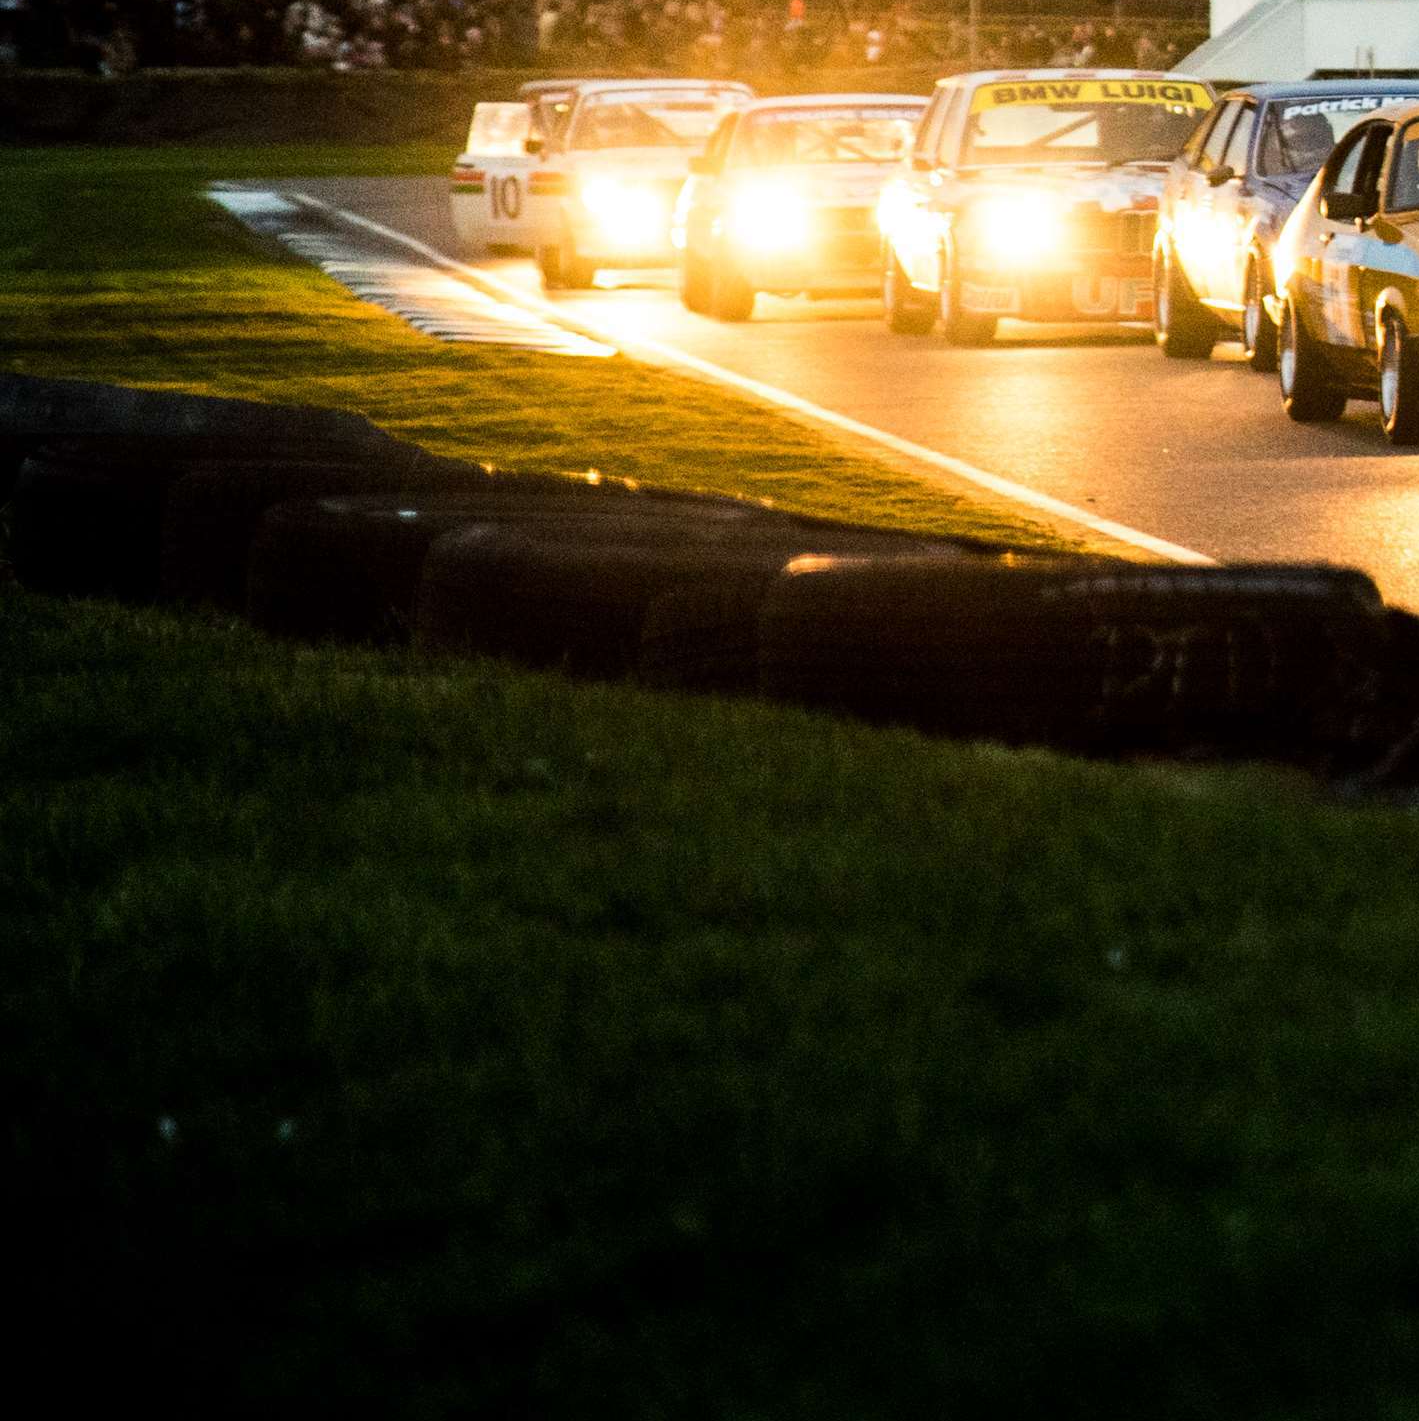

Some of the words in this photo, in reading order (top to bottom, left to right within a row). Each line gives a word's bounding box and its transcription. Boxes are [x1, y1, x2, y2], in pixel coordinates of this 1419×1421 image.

[992, 84, 1082, 104] BMW
[1101, 83, 1195, 103] LUIGI
[1283, 97, 1377, 121] Patrick
[491, 174, 522, 220] 10
